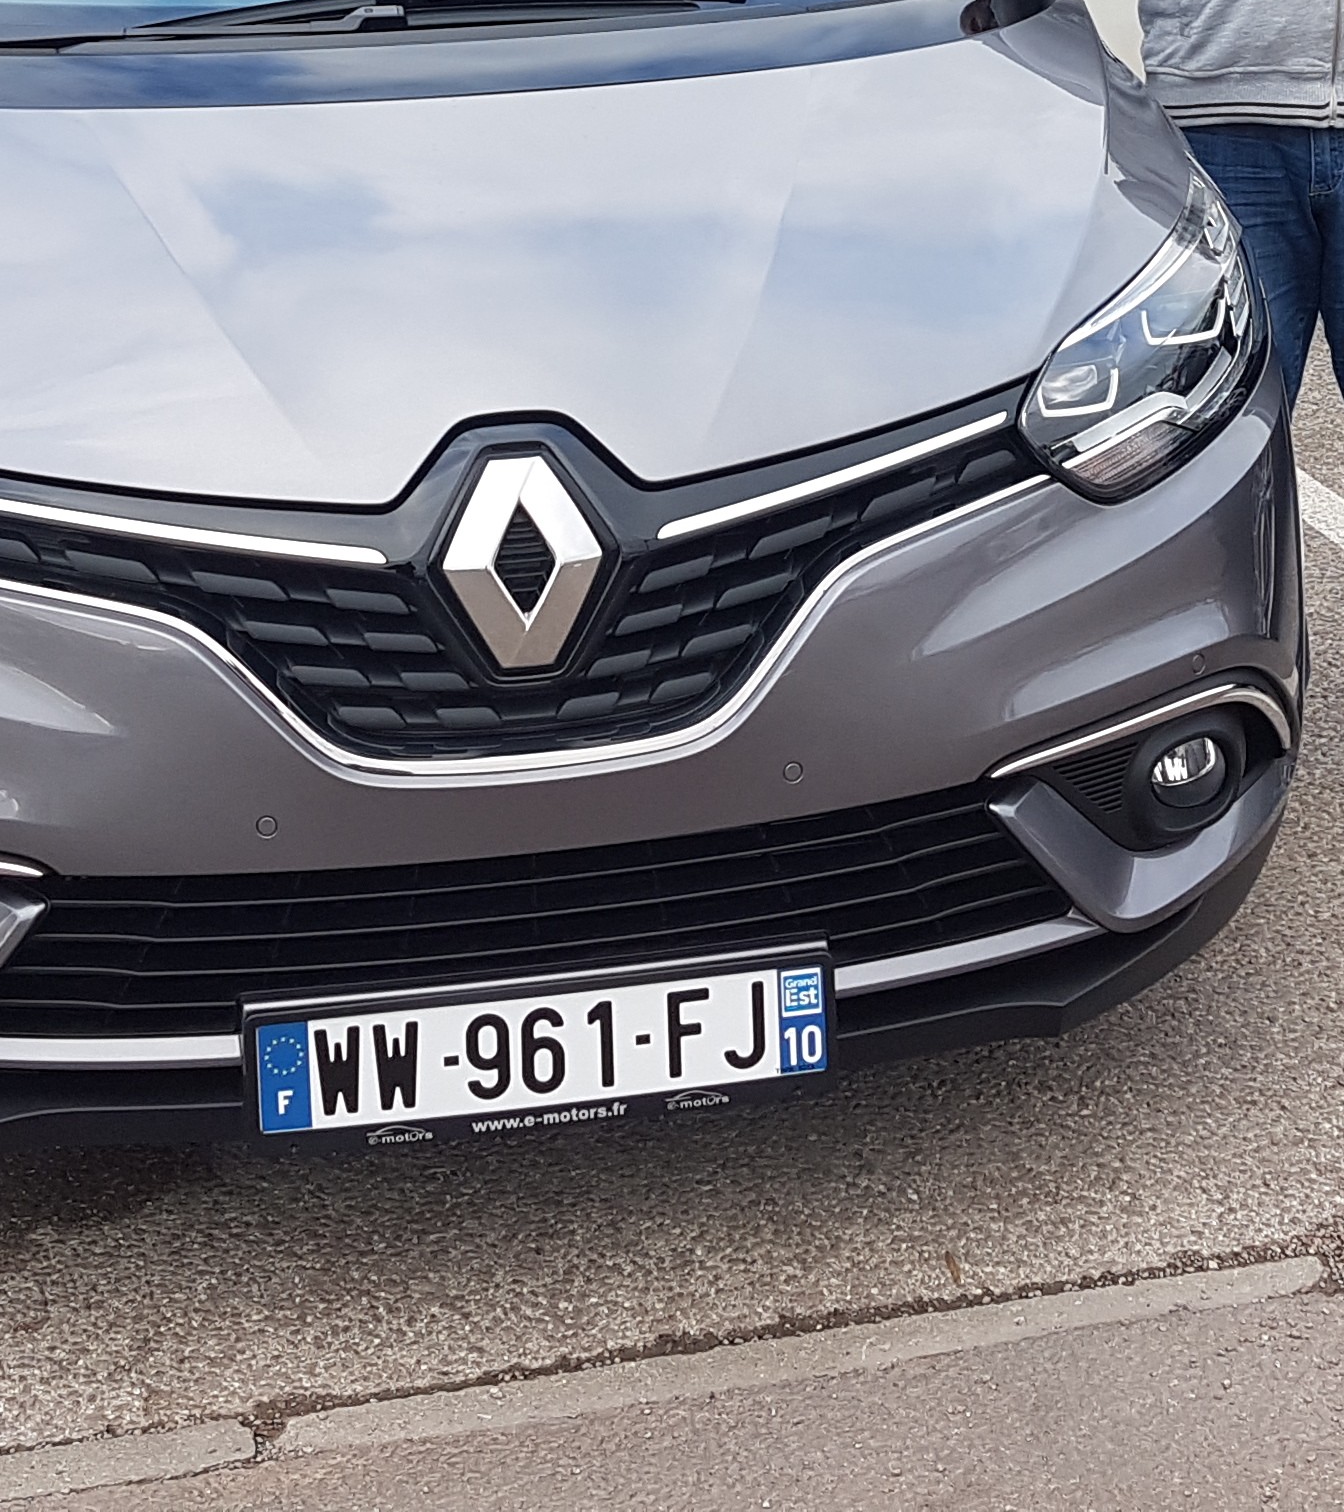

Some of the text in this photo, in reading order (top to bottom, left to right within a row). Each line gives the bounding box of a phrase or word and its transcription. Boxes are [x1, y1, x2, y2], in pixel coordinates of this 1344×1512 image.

[785, 975, 818, 988] Grand
[785, 987, 818, 1007] Est
[313, 980, 766, 1116] WW-961-FJ
[784, 1024, 822, 1066] 10
[277, 1090, 294, 1115] F
[471, 1101, 628, 1133] www.e-motors.fr
